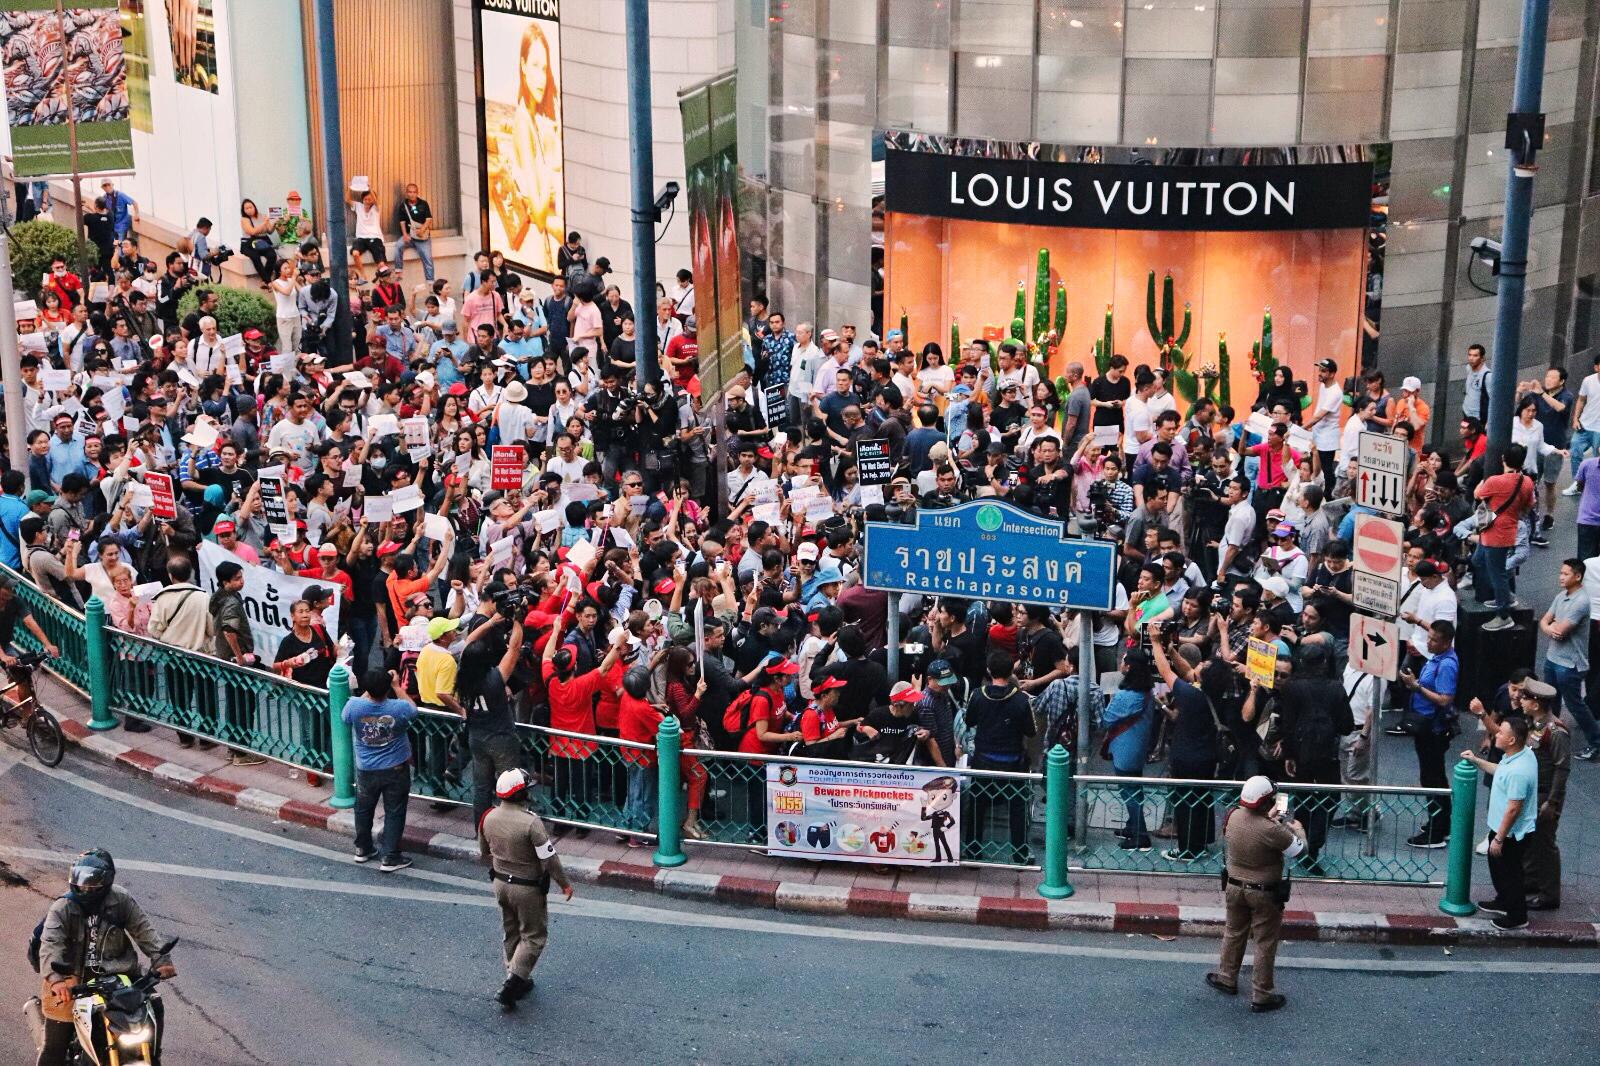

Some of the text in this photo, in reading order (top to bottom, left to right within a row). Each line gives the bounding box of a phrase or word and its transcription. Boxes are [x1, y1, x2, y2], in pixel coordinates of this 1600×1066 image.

[515, 0, 559, 17] VUITTON
[951, 171, 1295, 216] LOUIS VUITTON
[1372, 440, 1392, 455] ระวัง
[934, 514, 961, 528] แยก
[1002, 521, 1059, 537] Intersection
[981, 533, 997, 541] 003
[895, 546, 1088, 584] ราชประสงค์
[906, 572, 1069, 603] Ratchaprasong
[809, 768, 915, 781] กองบัญชาการตำรวจท่องเที่ยว
[814, 786, 914, 801] Beware Pickpockets
[775, 797, 803, 811] 1155
